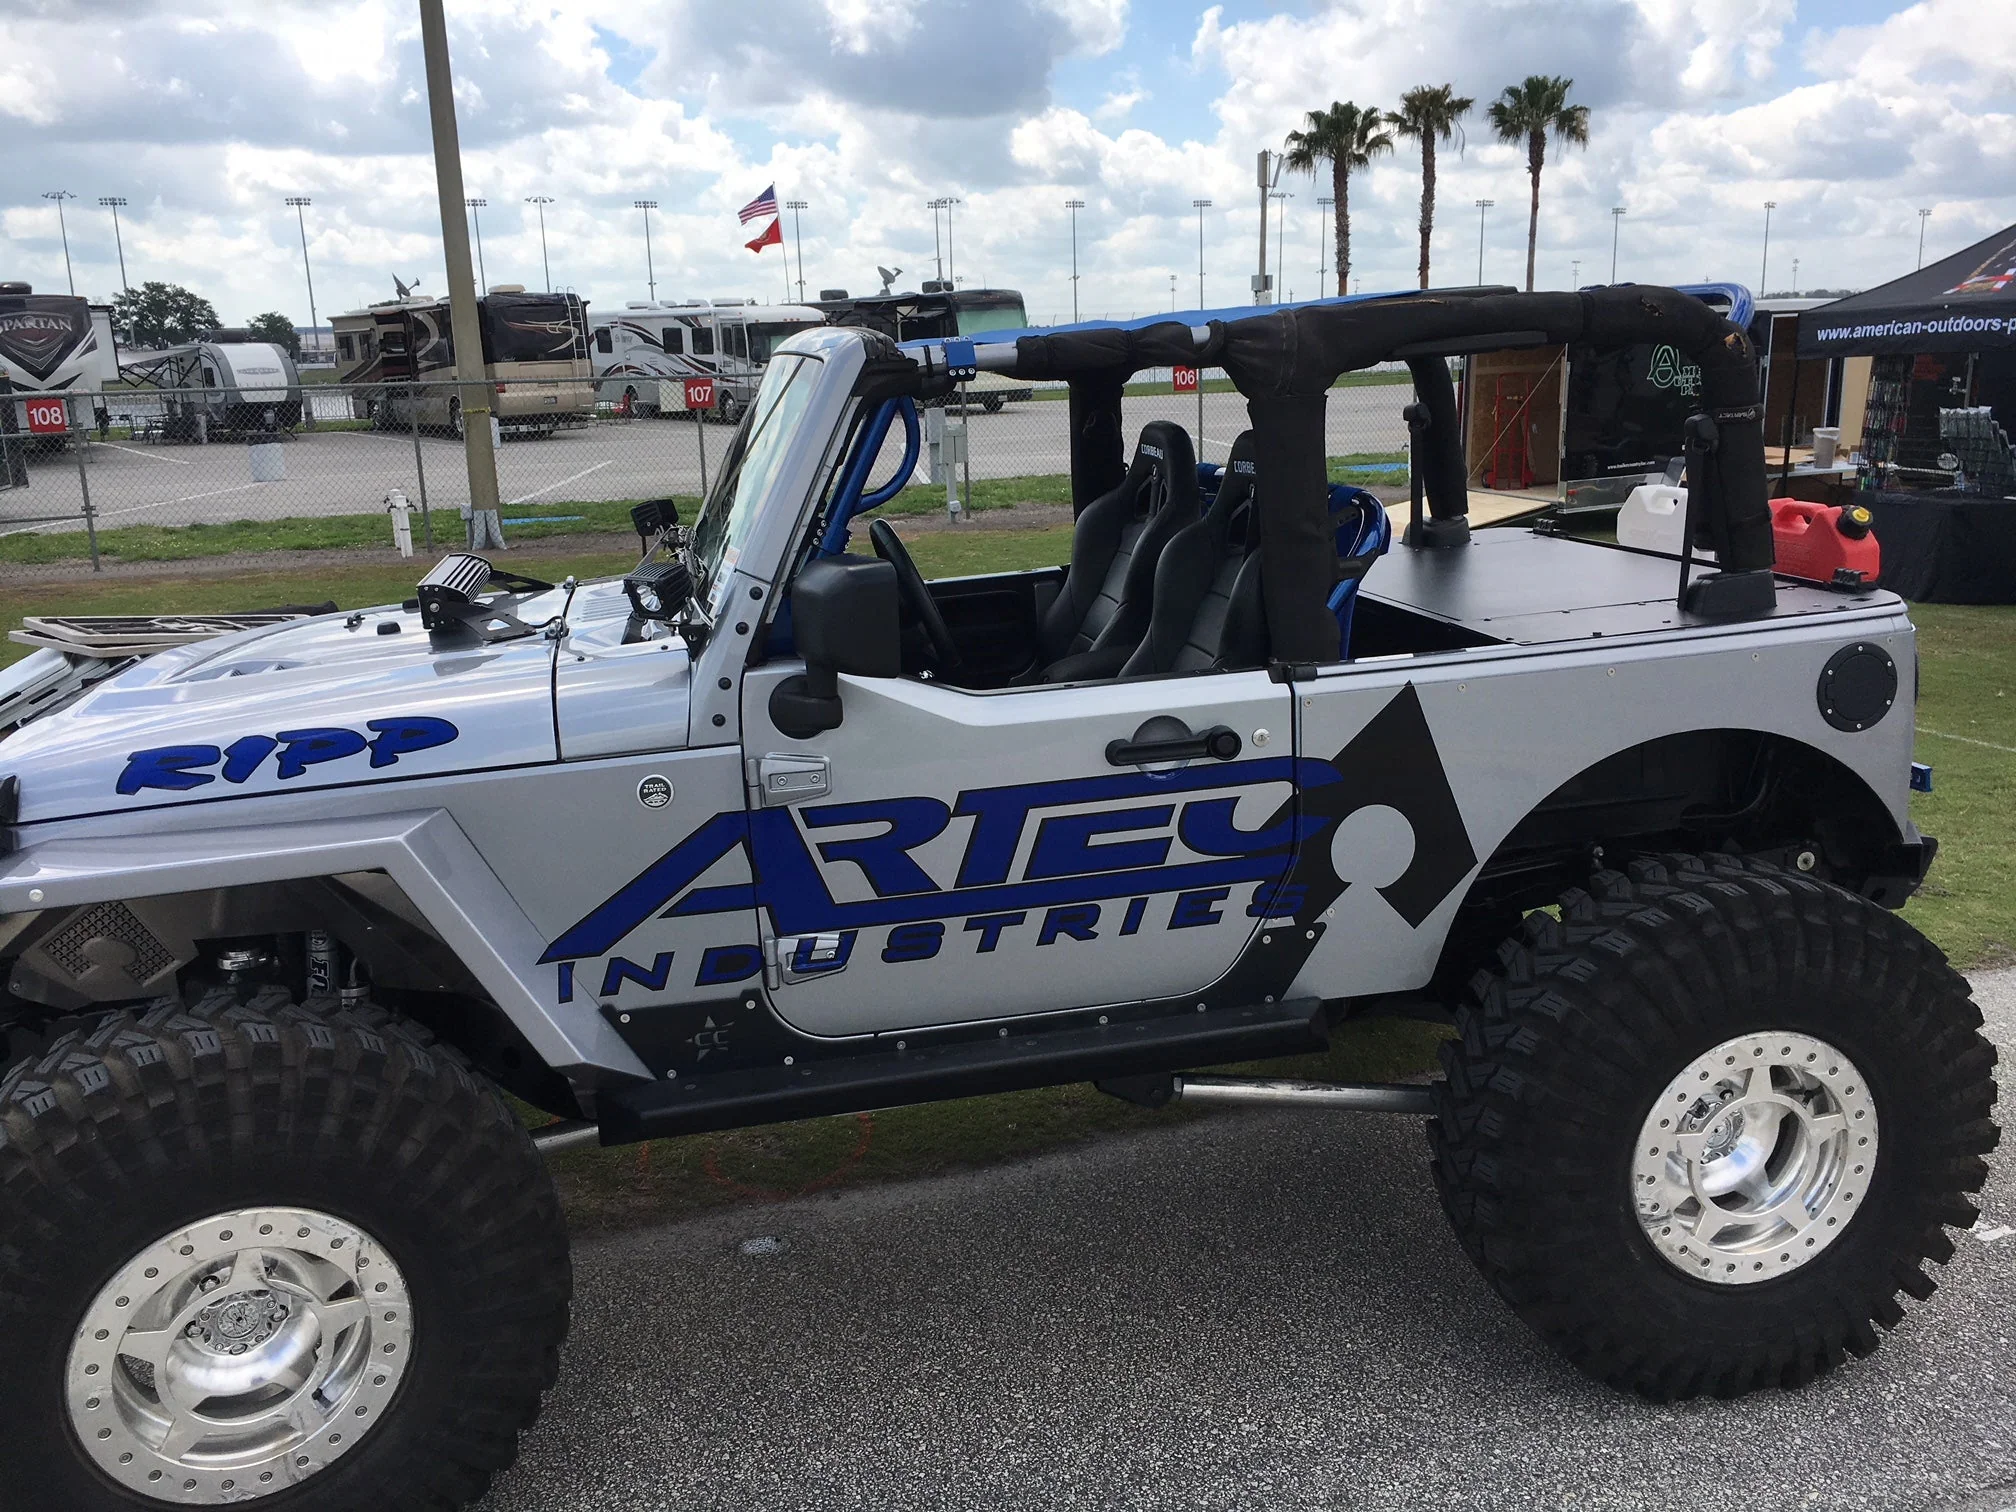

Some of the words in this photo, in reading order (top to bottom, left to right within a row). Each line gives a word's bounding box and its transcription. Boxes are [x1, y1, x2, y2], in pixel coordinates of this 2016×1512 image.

[1174, 370, 1195, 386] 106
[688, 386, 712, 403] 107
[30, 407, 63, 425] 108
[1141, 443, 1164, 460] CORBEAU
[1234, 460, 1257, 475] CORBE
[115, 715, 460, 795] RIPP
[536, 756, 1343, 966] ARTEC
[557, 882, 1308, 1004] INDUSTRIES
